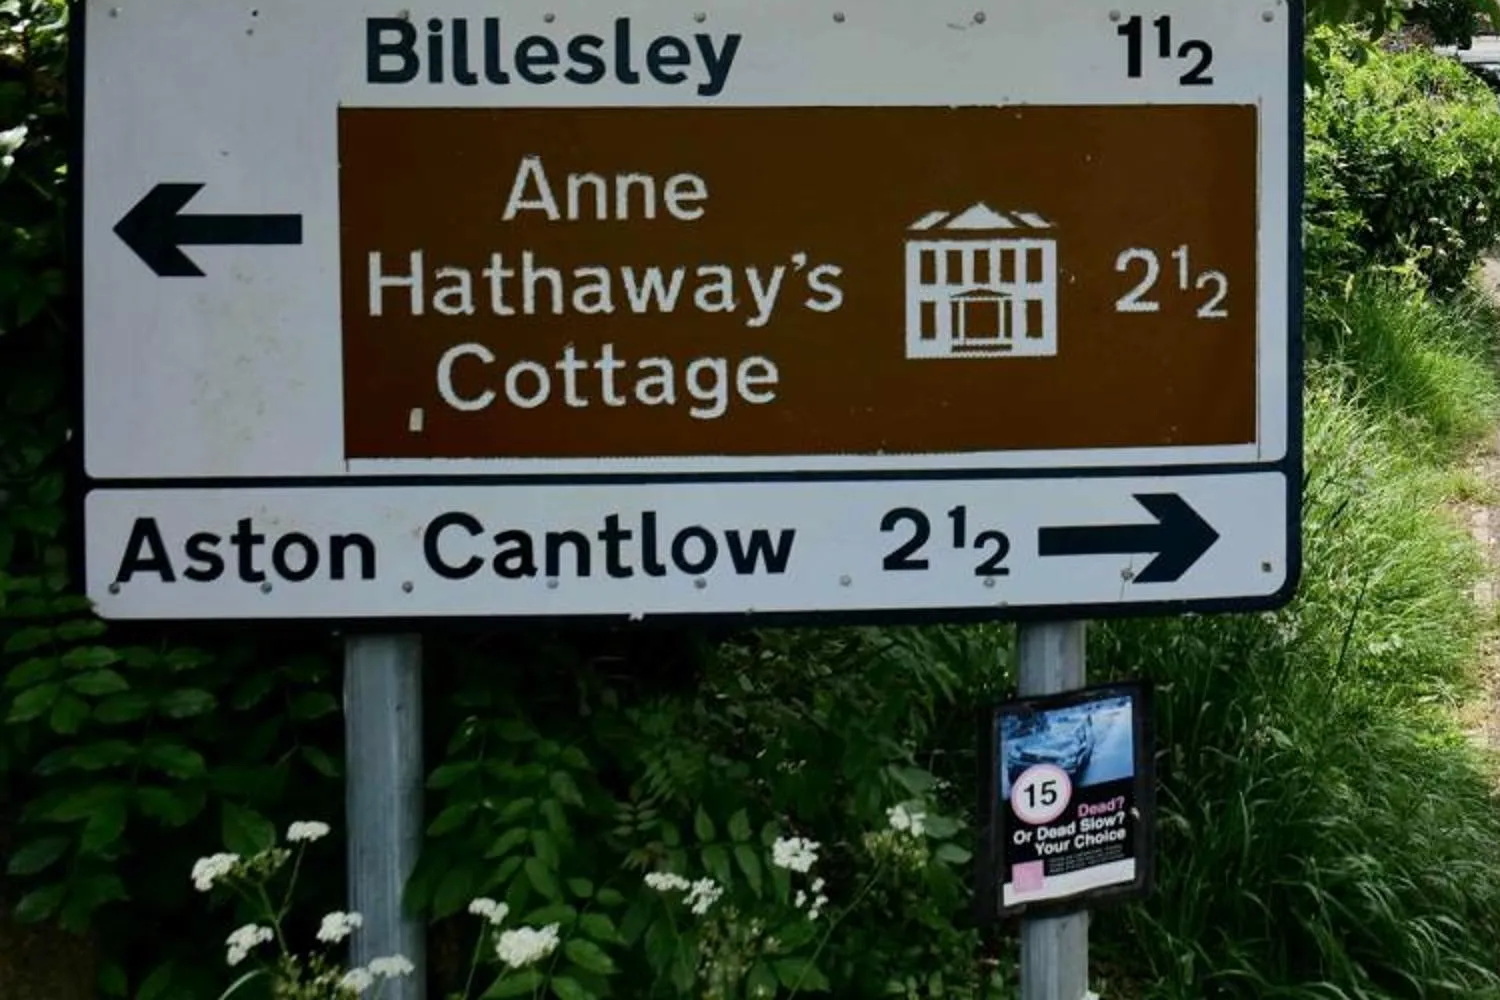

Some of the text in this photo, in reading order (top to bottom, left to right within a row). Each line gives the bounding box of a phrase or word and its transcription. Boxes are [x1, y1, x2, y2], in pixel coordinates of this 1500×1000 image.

[365, 16, 741, 96] Billesley
[503, 155, 708, 221] Anne
[369, 251, 843, 327] Hathaway's
[437, 343, 779, 419] Cottage
[114, 516, 376, 584] Aston
[423, 511, 796, 580] Cantlow
[1024, 779, 1057, 808] 15
[1078, 796, 1125, 817] Dead?
[1013, 811, 1125, 845] Or Dead Slow?
[1036, 829, 1126, 856] Your Choice
